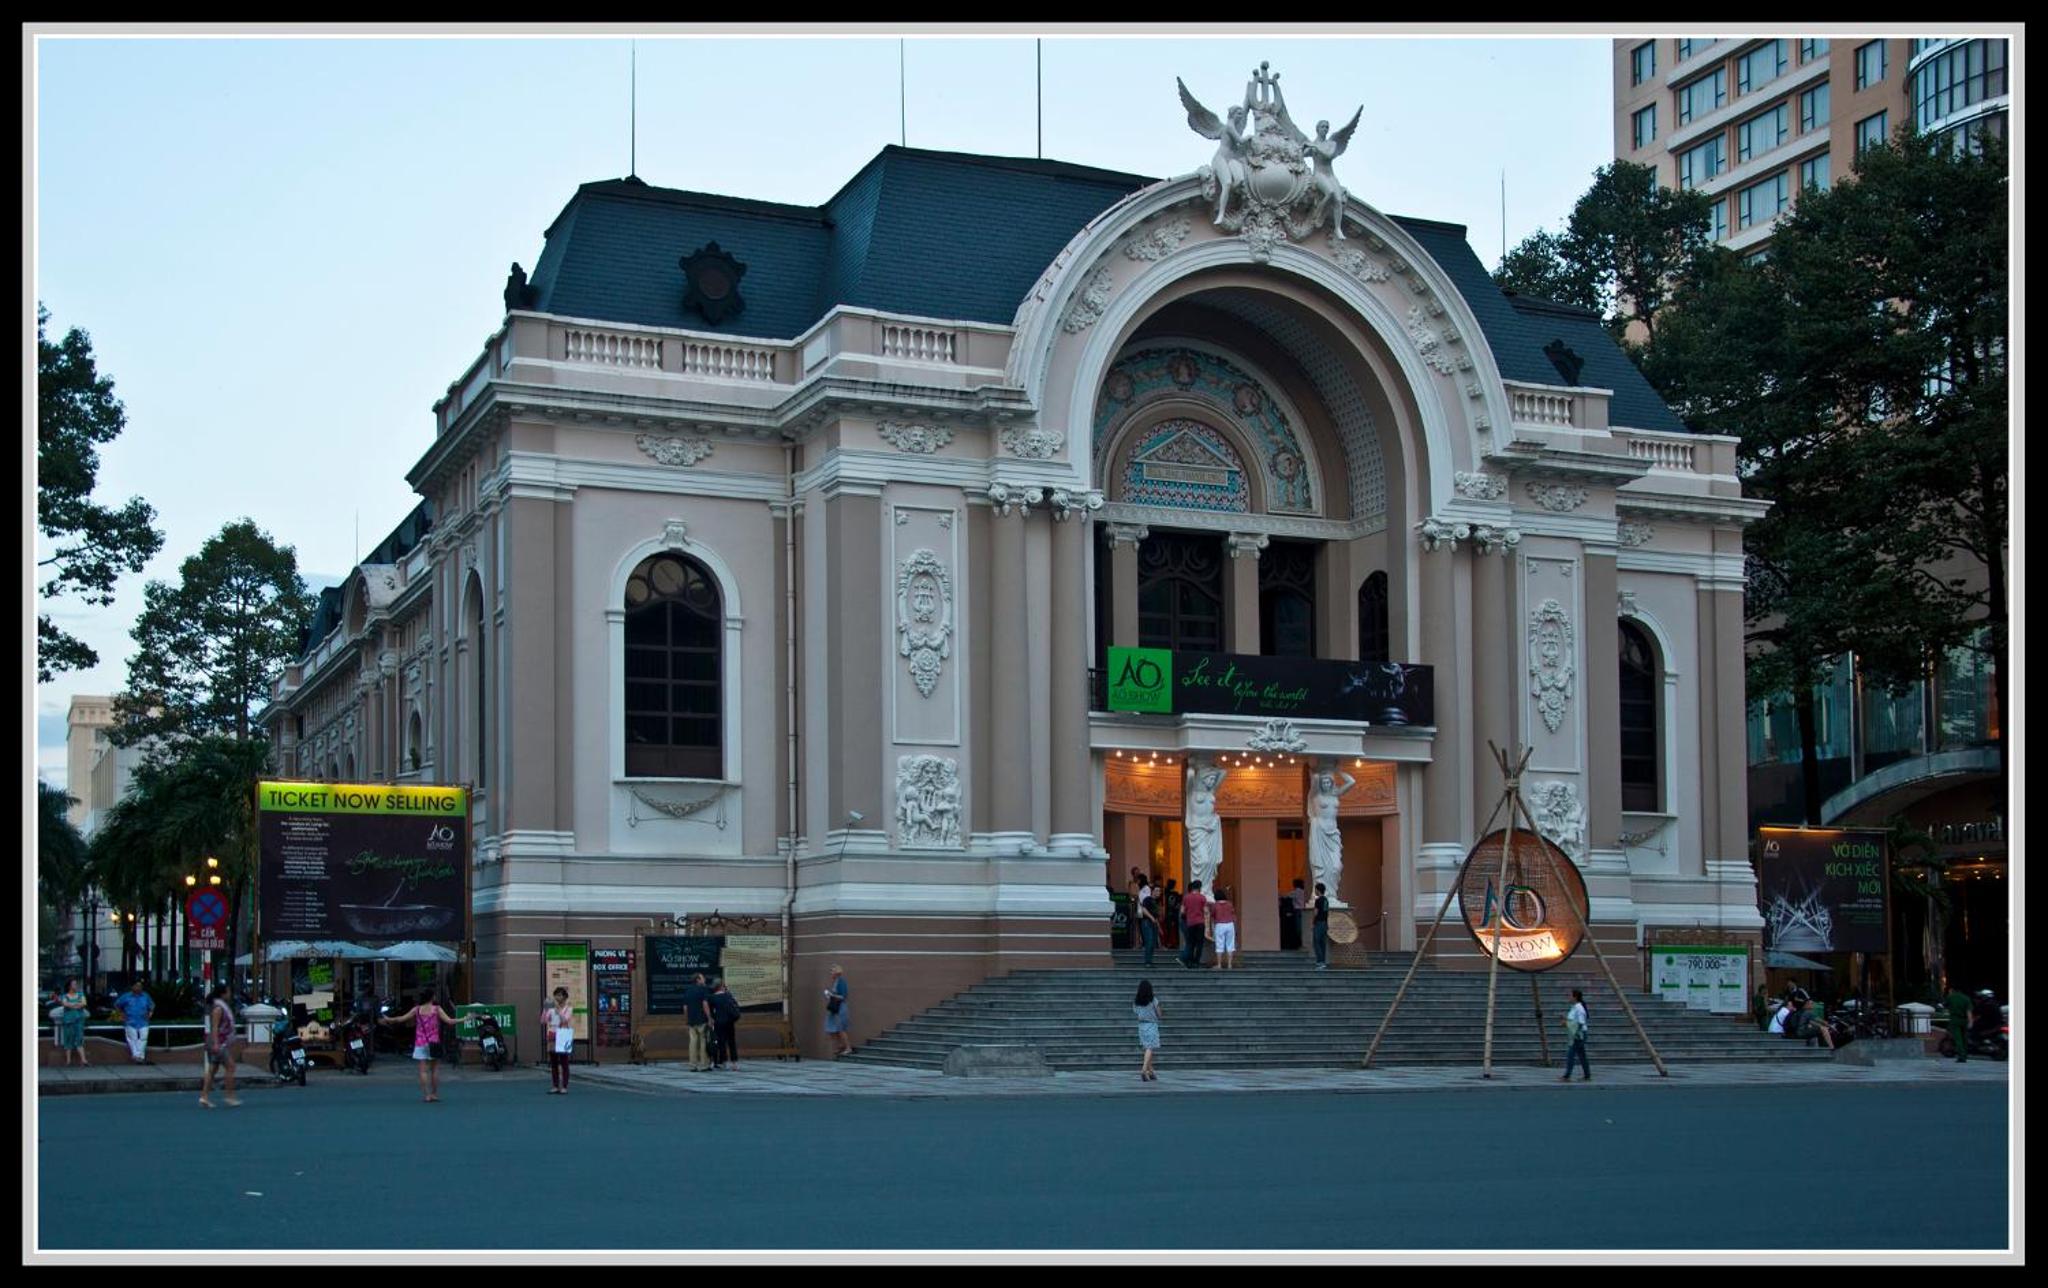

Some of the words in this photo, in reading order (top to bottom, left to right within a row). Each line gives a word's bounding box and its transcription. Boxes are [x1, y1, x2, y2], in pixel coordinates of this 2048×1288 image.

[268, 790, 329, 809] TICKET
[333, 793, 381, 811] NOW
[386, 794, 456, 812] SELLING
[1501, 936, 1551, 953] SHOW
